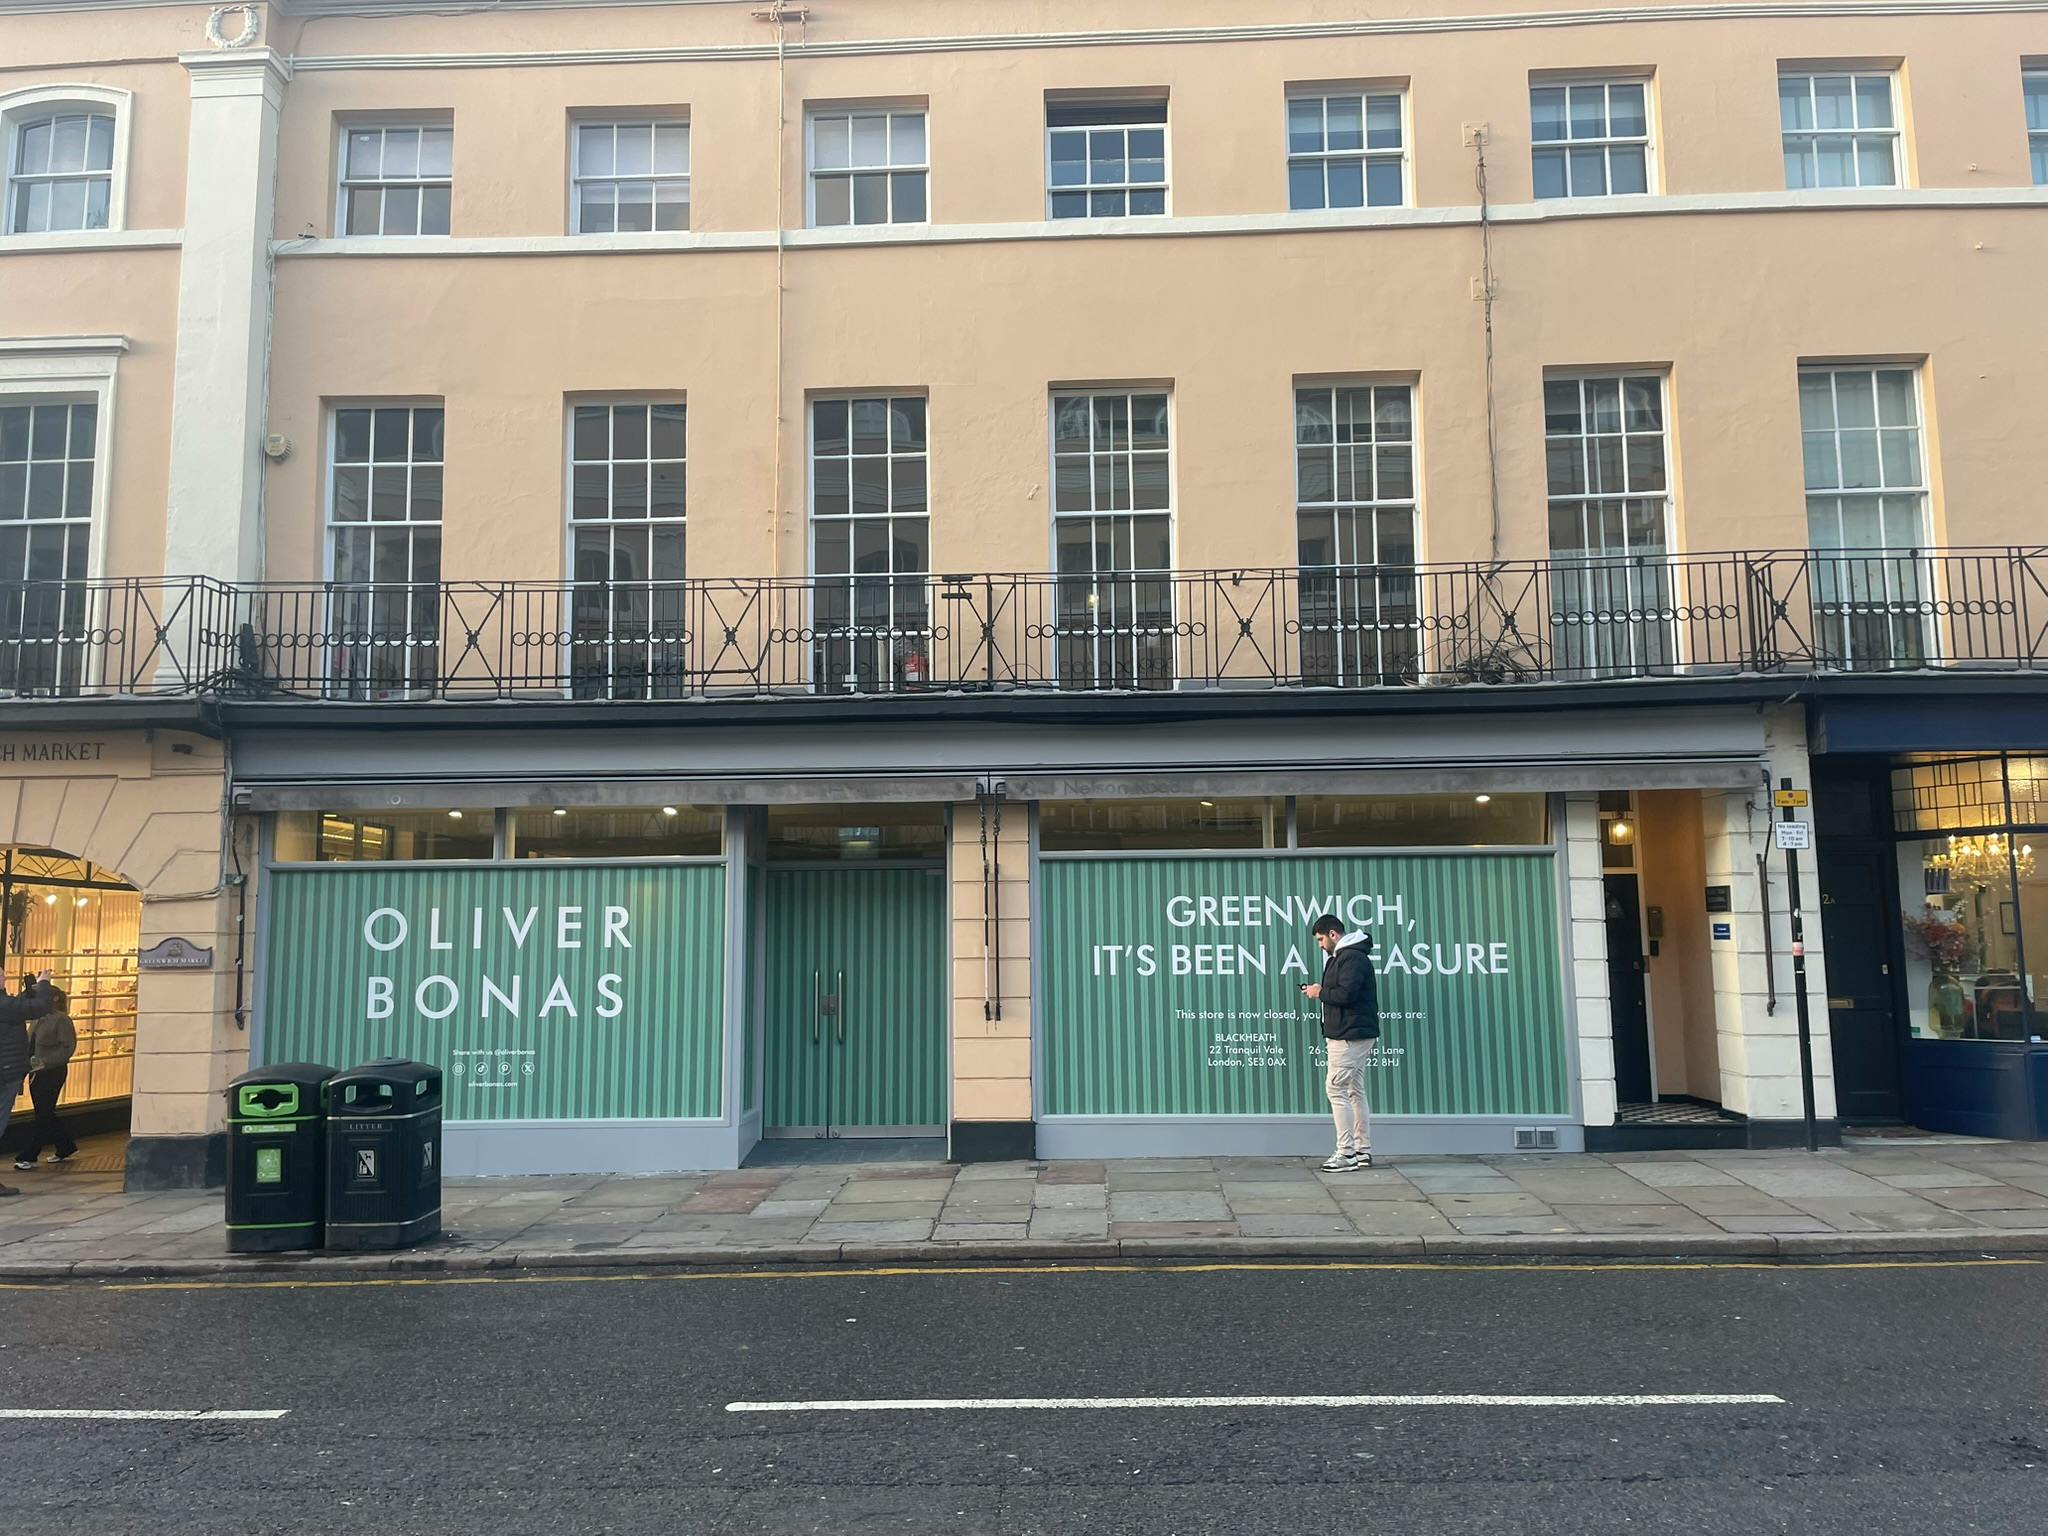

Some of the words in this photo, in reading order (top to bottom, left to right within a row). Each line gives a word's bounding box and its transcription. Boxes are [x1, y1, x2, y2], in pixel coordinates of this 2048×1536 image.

[23, 743, 104, 760] MARKET
[1166, 894, 1415, 932] GREENWICH,
[364, 906, 632, 951] OLIVER
[1094, 944, 1156, 976] IT’S
[1172, 943, 1266, 975] BEEN
[1280, 943, 1309, 975] A
[1323, 942, 1508, 975] ASURE
[367, 973, 623, 1019] BONAS
[1176, 1009, 1196, 1019] This
[1199, 1010, 1224, 1019] store
[1228, 1009, 1236, 1019] is
[1239, 1011, 1260, 1019] now
[1264, 1009, 1299, 1021] closed,
[1303, 1012, 1321, 1021] you
[1405, 1011, 1427, 1019] are:
[1215, 1033, 1277, 1042] BLACKHEATH
[494, 1049, 536, 1057] @oliverbonas
[1209, 1045, 1221, 1055] 22
[1224, 1045, 1260, 1056] Tranquil
[1264, 1045, 1284, 1054] Vale
[1382, 1045, 1405, 1055] Lane
[1208, 1057, 1245, 1067] London,
[1248, 1057, 1265, 1067] SE3
[1381, 1057, 1399, 1067] 8HJ
